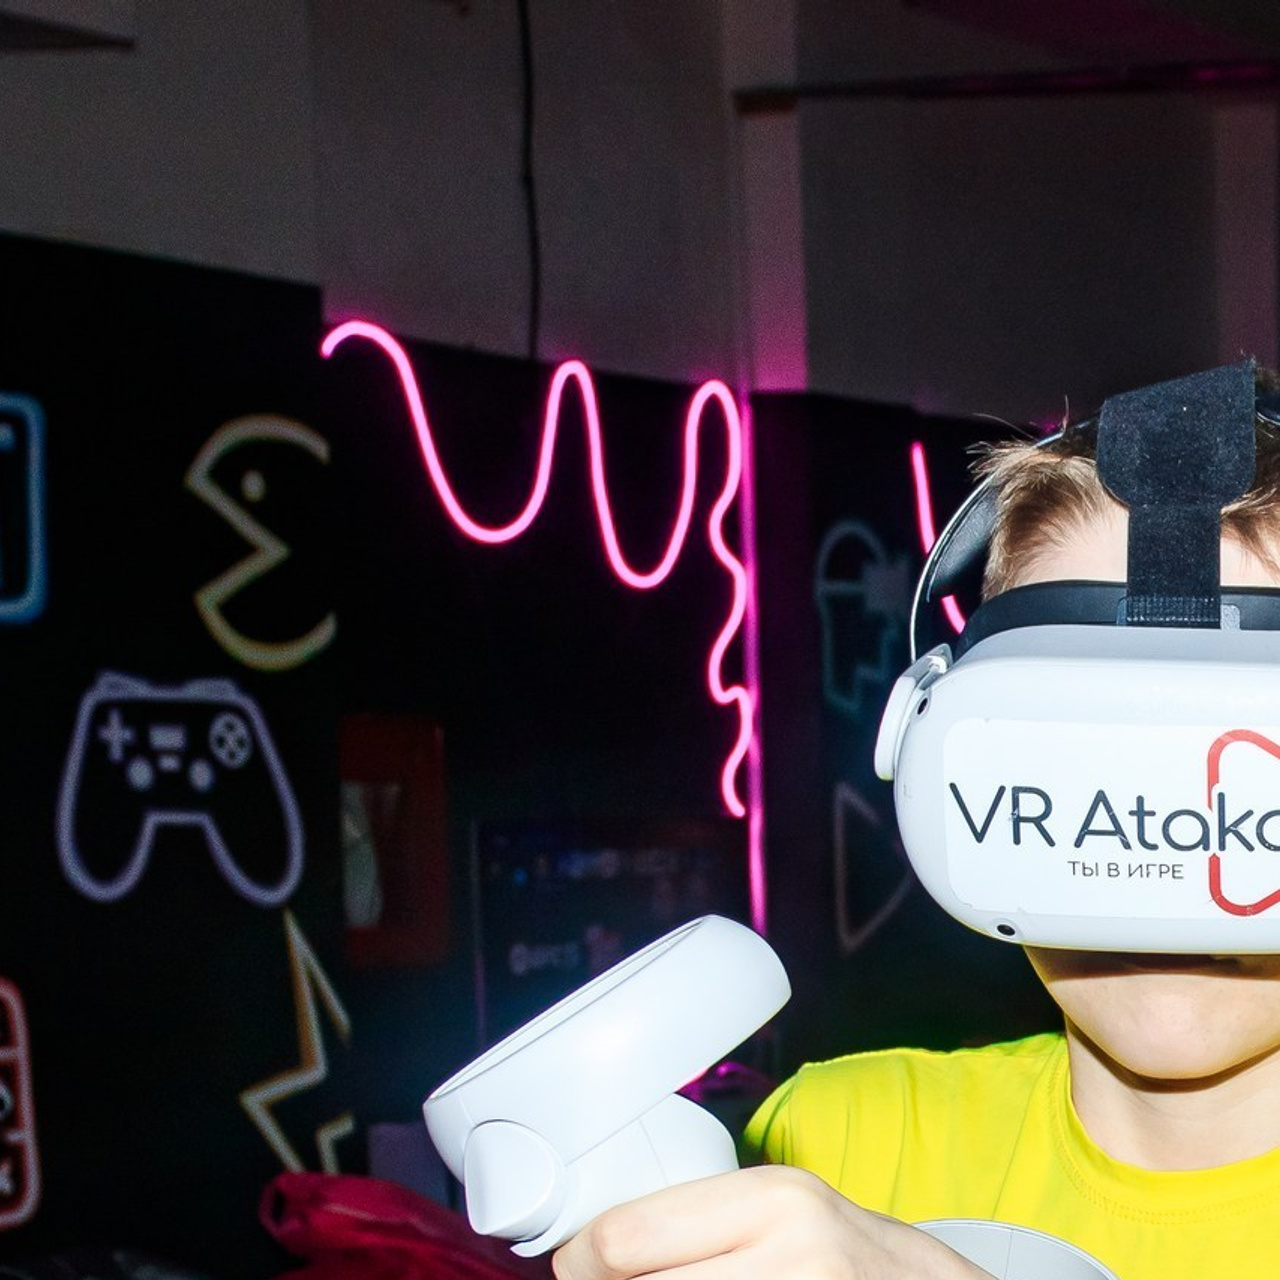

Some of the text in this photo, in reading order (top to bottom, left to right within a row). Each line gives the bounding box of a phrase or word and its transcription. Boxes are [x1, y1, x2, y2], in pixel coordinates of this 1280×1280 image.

[949, 782, 1056, 848] VR
[1067, 860, 1184, 880] ТЫ В ИГРЕ
